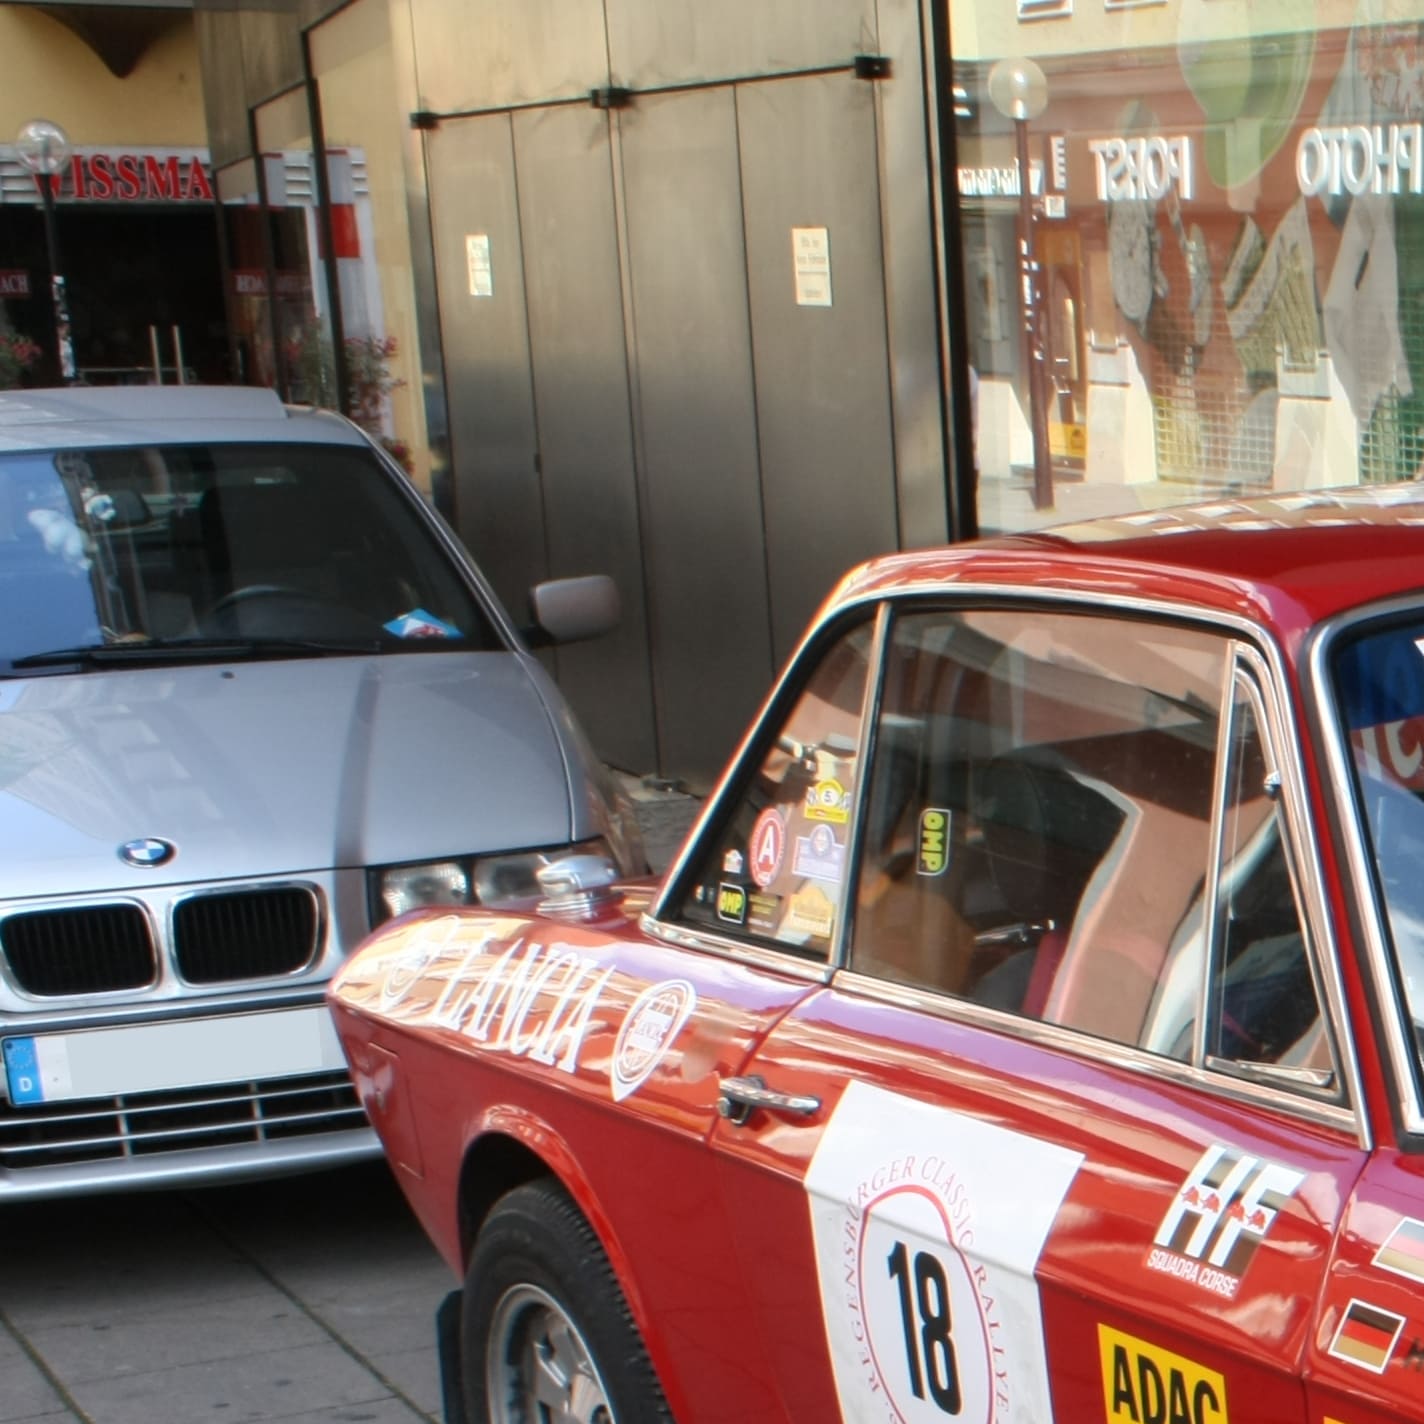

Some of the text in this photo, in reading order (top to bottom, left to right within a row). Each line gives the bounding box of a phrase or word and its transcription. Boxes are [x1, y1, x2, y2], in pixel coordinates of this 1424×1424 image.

[921, 811, 945, 872] OMP
[432, 931, 616, 1074] LANCIA
[19, 1076, 33, 1093] D
[920, 1155, 975, 1248] CLASSIC
[1153, 1143, 1307, 1268] HF
[1146, 1248, 1240, 1297] SQUADRA CORSE
[886, 1239, 964, 1417] 18
